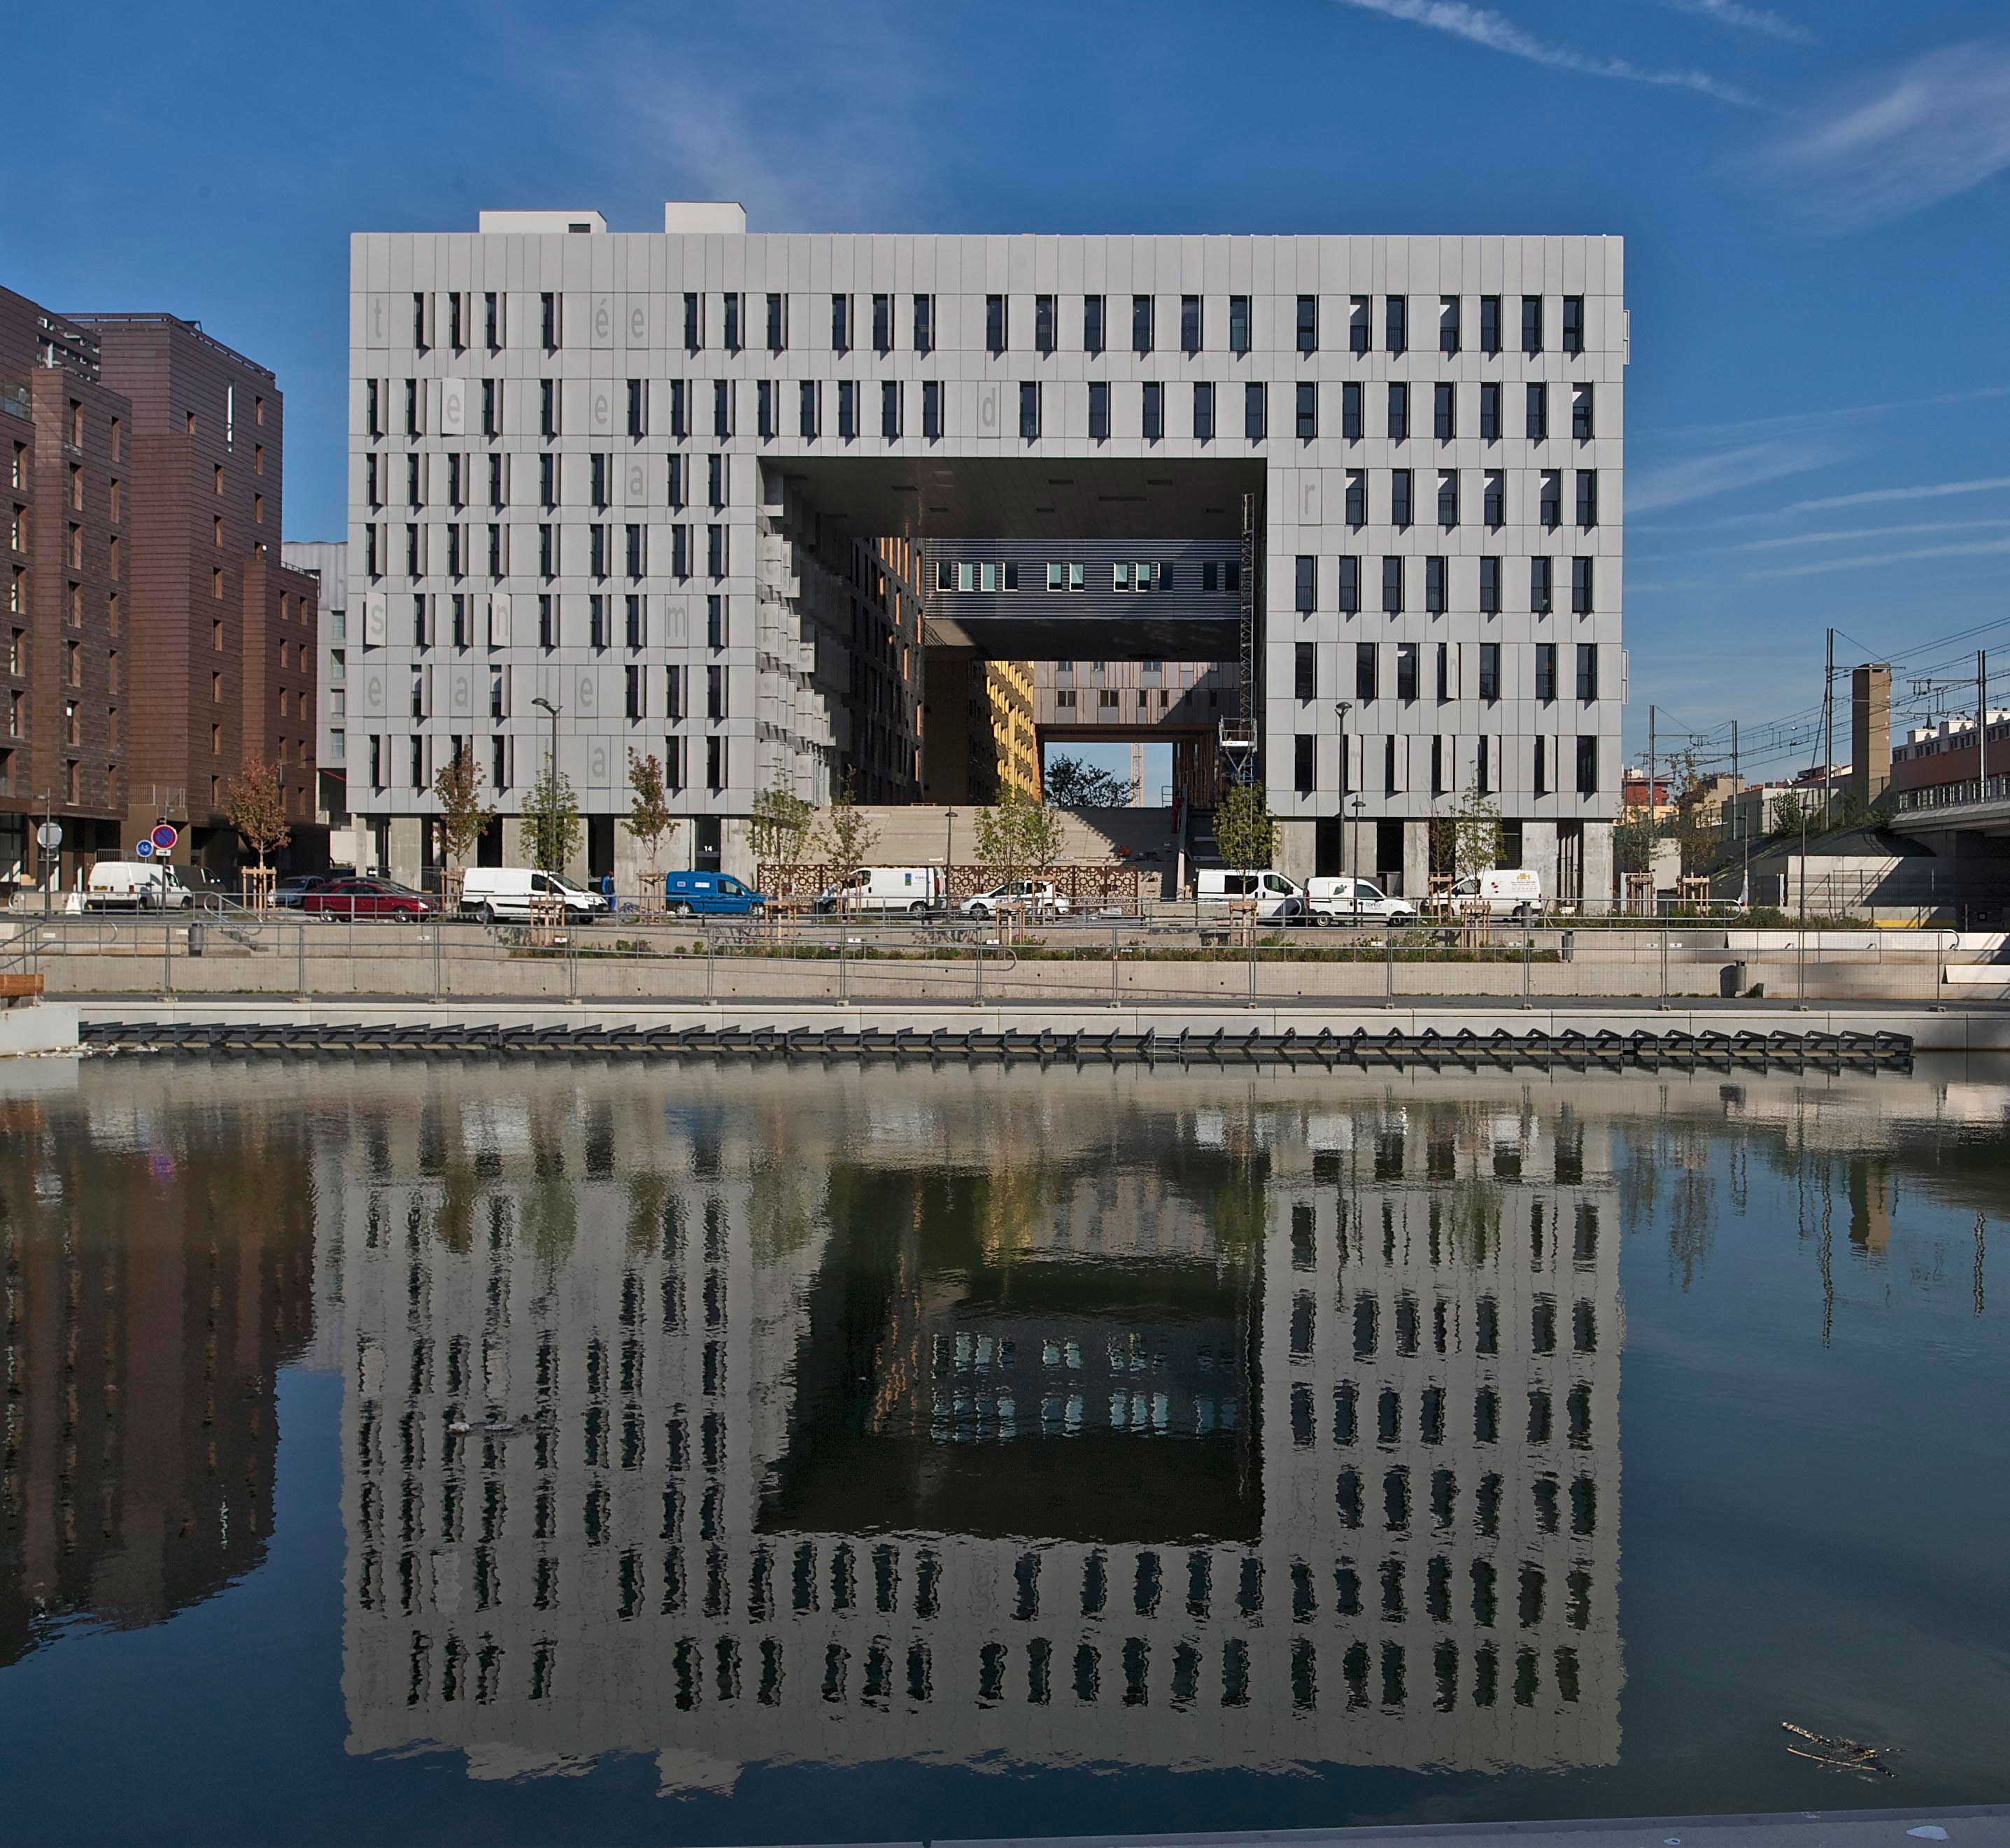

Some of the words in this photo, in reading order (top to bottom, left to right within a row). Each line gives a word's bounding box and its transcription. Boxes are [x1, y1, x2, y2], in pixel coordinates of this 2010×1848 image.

[595, 298, 609, 339] é
[631, 308, 644, 339] e
[447, 393, 461, 424] e
[595, 394, 608, 425] e
[982, 387, 996, 427] d
[630, 465, 644, 495] a
[1305, 483, 1316, 515] r
[371, 604, 385, 636] s
[497, 605, 509, 637] n
[667, 605, 686, 639] m
[368, 676, 382, 707] e
[455, 676, 469, 708] a
[580, 676, 593, 708] e
[592, 747, 606, 779] a
